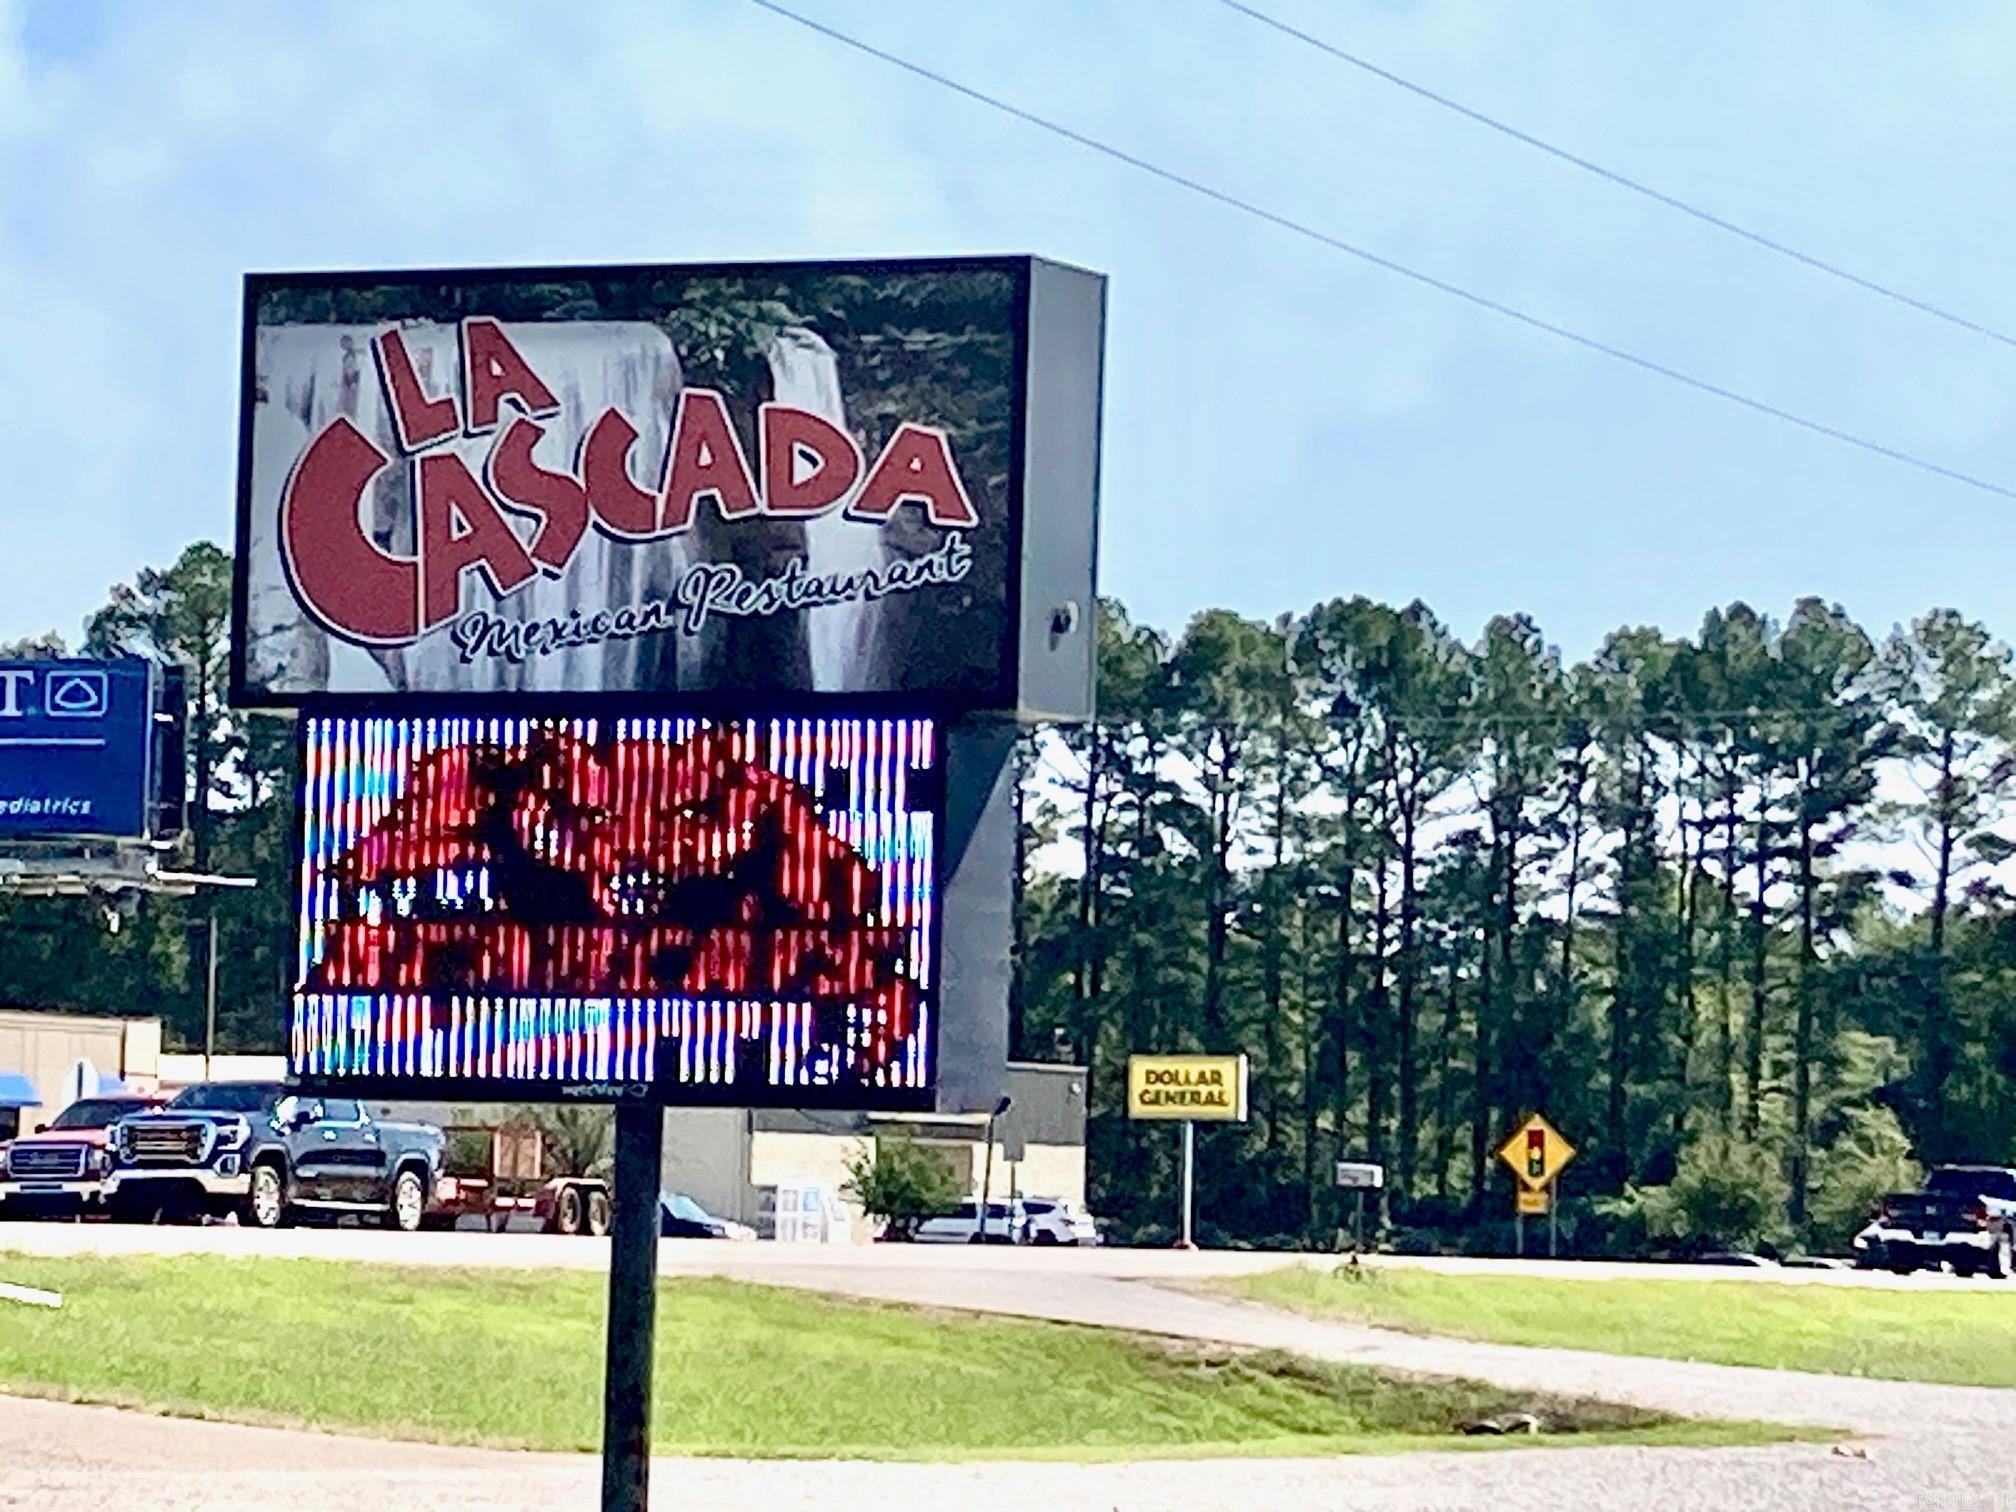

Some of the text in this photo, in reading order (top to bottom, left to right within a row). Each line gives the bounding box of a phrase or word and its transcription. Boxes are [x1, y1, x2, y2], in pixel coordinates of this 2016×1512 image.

[375, 316, 561, 453] LA
[282, 388, 979, 646] CASCADA
[456, 531, 973, 663] Mexican Restaurant
[1138, 1089, 1230, 1107] GENERAL
[1145, 1068, 1224, 1087] DOLLAR
